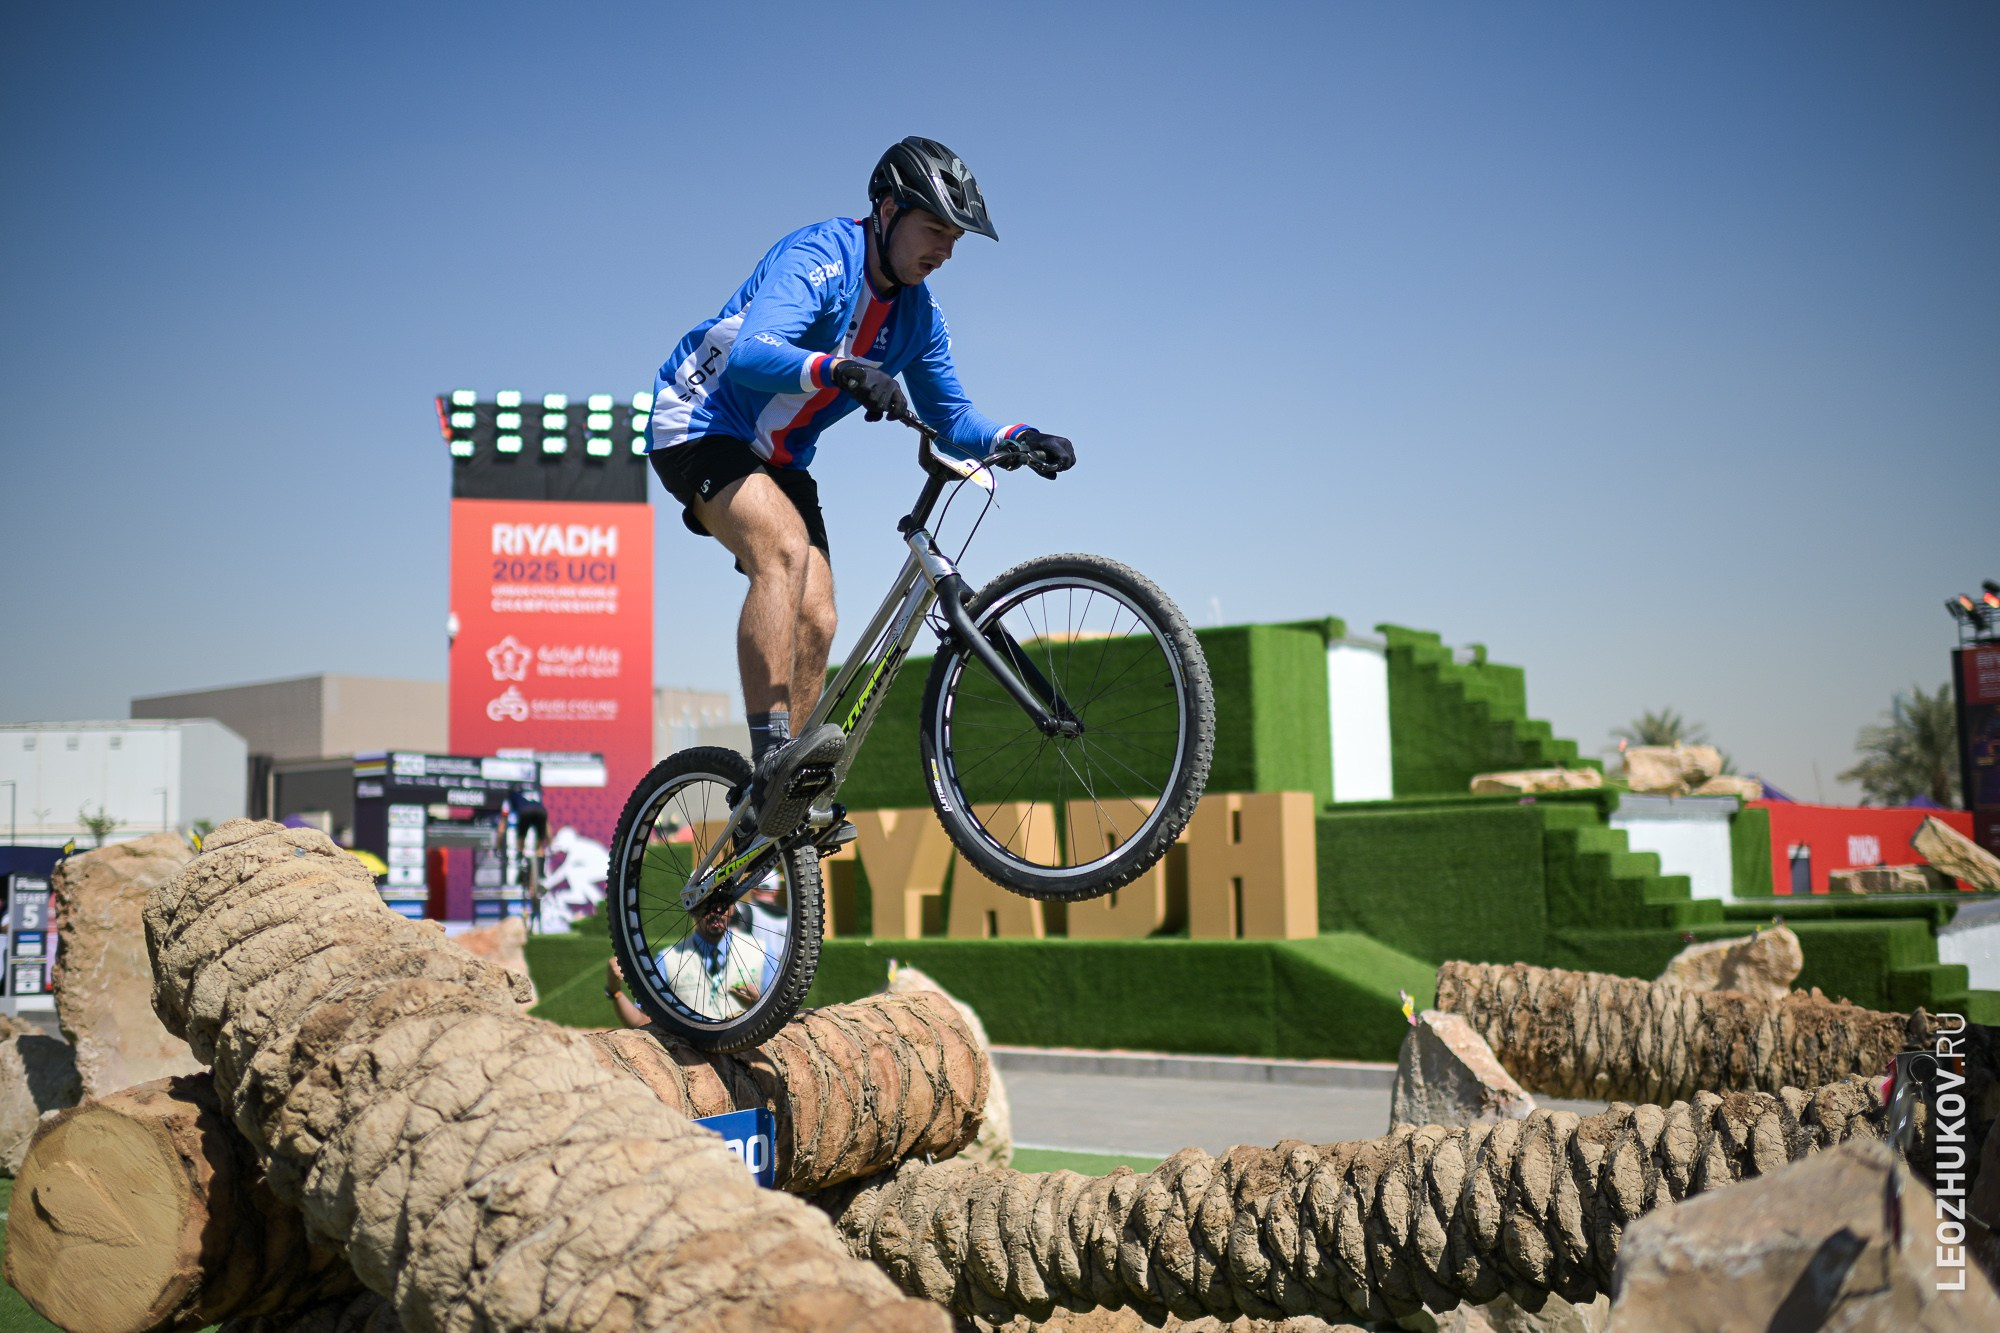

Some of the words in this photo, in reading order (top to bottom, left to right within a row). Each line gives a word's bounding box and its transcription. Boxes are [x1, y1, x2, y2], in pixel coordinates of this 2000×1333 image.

[491, 523, 619, 557] RIYADH
[493, 560, 560, 583] 2025
[568, 562, 617, 583] UCI
[692, 790, 1316, 940] YADH
[15, 893, 47, 905] START
[22, 904, 39, 929] 5
